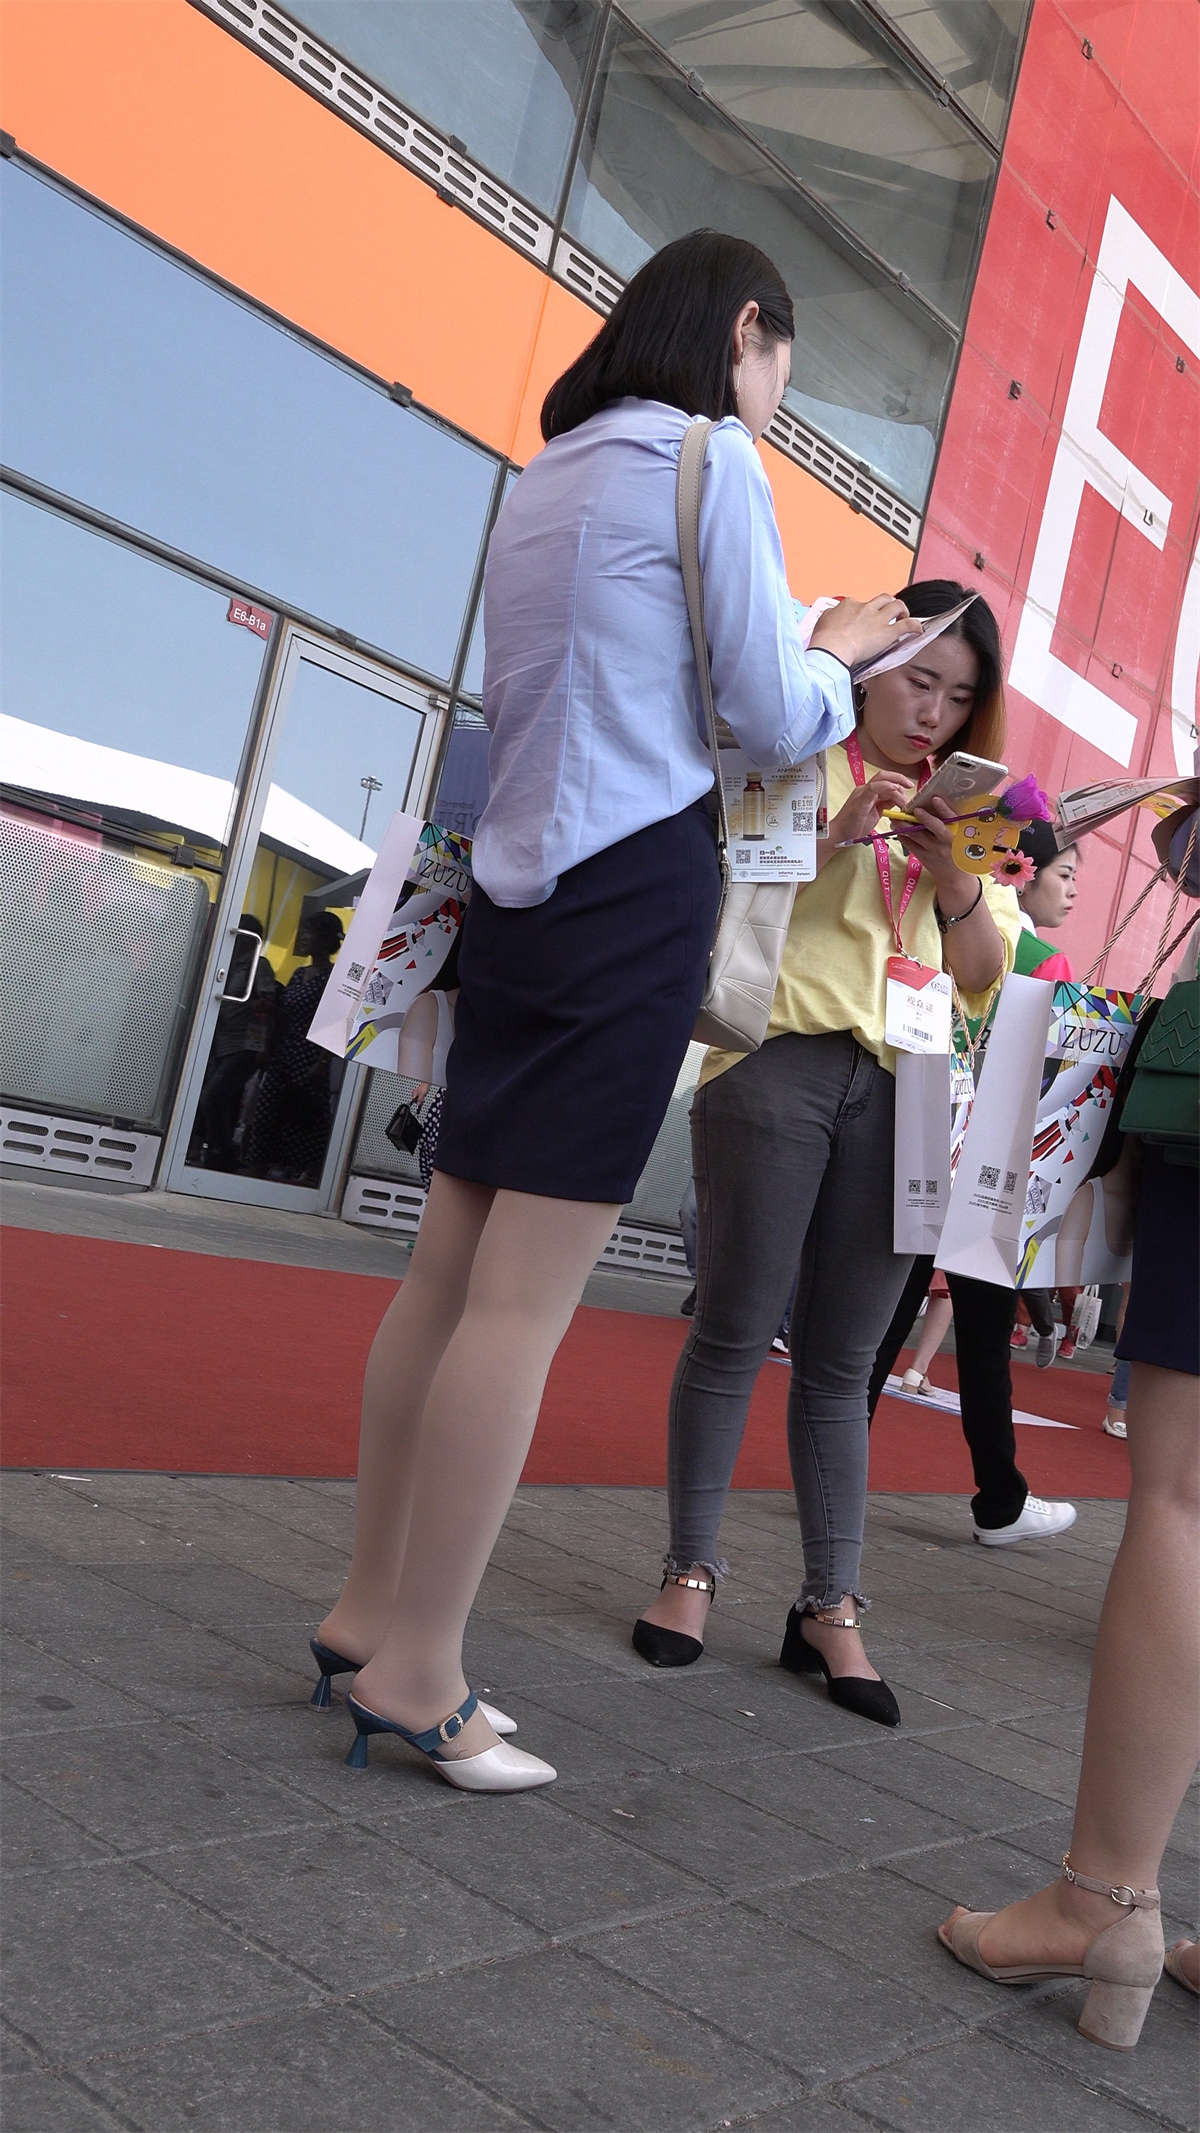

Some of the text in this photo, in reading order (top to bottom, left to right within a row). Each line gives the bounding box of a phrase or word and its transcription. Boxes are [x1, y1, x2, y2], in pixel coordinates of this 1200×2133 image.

[1008, 193, 1200, 777] E
[233, 607, 266, 631] E6-B1a
[420, 858, 471, 892] ZUZU
[1061, 1024, 1124, 1056] ZUZU
